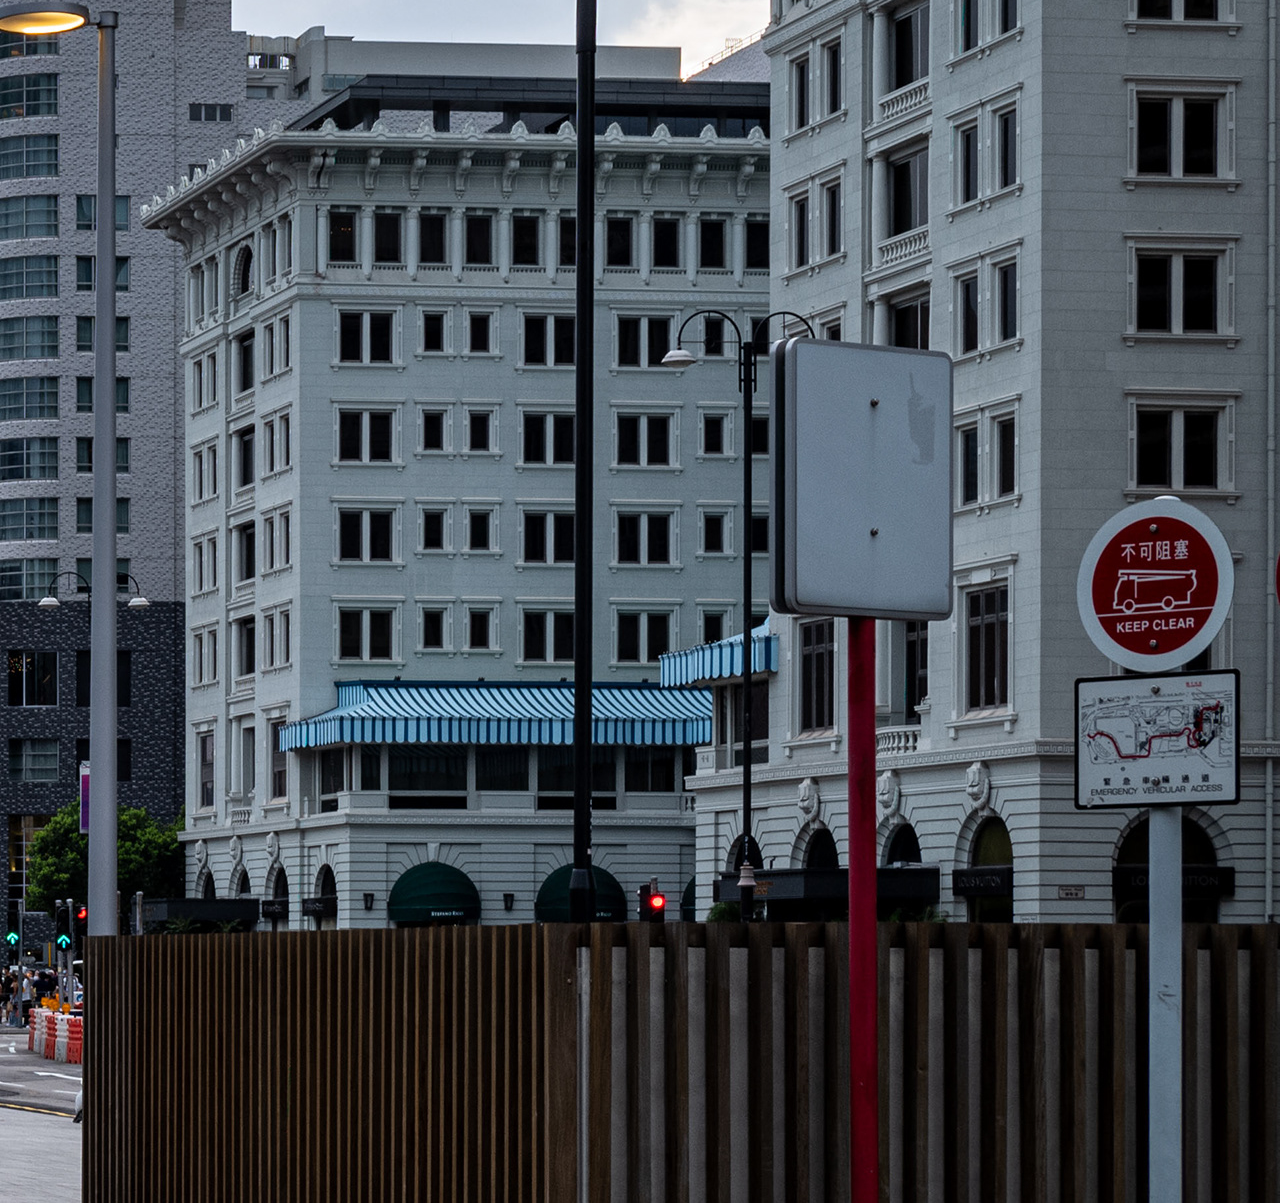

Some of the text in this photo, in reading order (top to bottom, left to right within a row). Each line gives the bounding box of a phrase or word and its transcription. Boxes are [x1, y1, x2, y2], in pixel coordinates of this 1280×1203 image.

[1120, 539, 1190, 563] 不可阻塞
[1116, 616, 1196, 634] KEEP CLEAR
[1090, 783, 1223, 796] EMERGENCY VEHICULAR ACCESS
